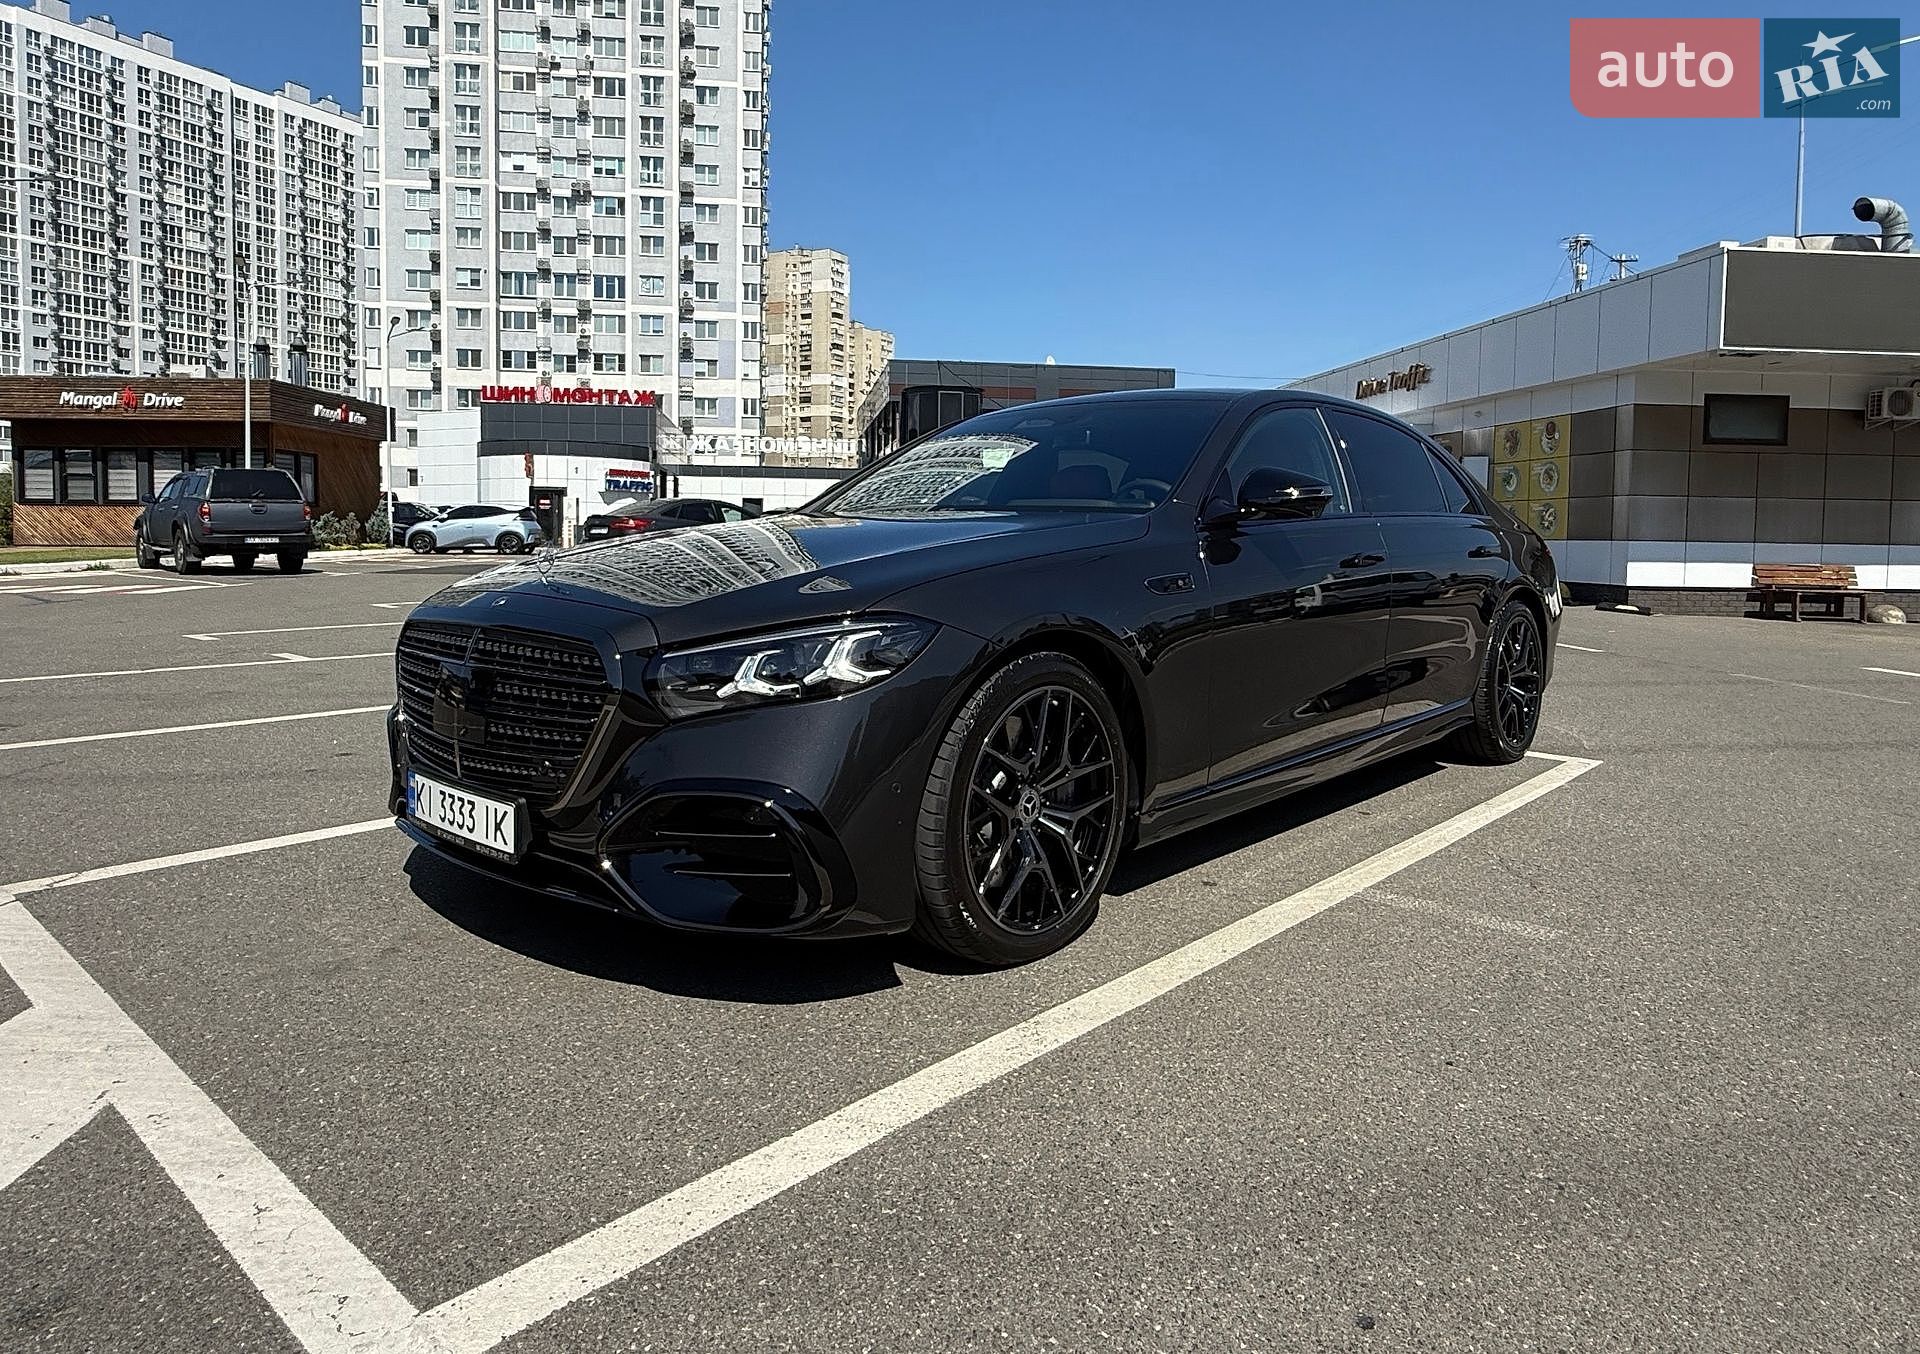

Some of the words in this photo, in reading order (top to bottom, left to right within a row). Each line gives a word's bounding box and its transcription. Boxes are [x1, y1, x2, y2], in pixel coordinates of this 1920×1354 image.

[59, 391, 118, 409] Mangal
[143, 392, 184, 407] Drive
[415, 779, 432, 818] KI
[438, 790, 476, 834] 3333
[485, 805, 508, 846] IK
